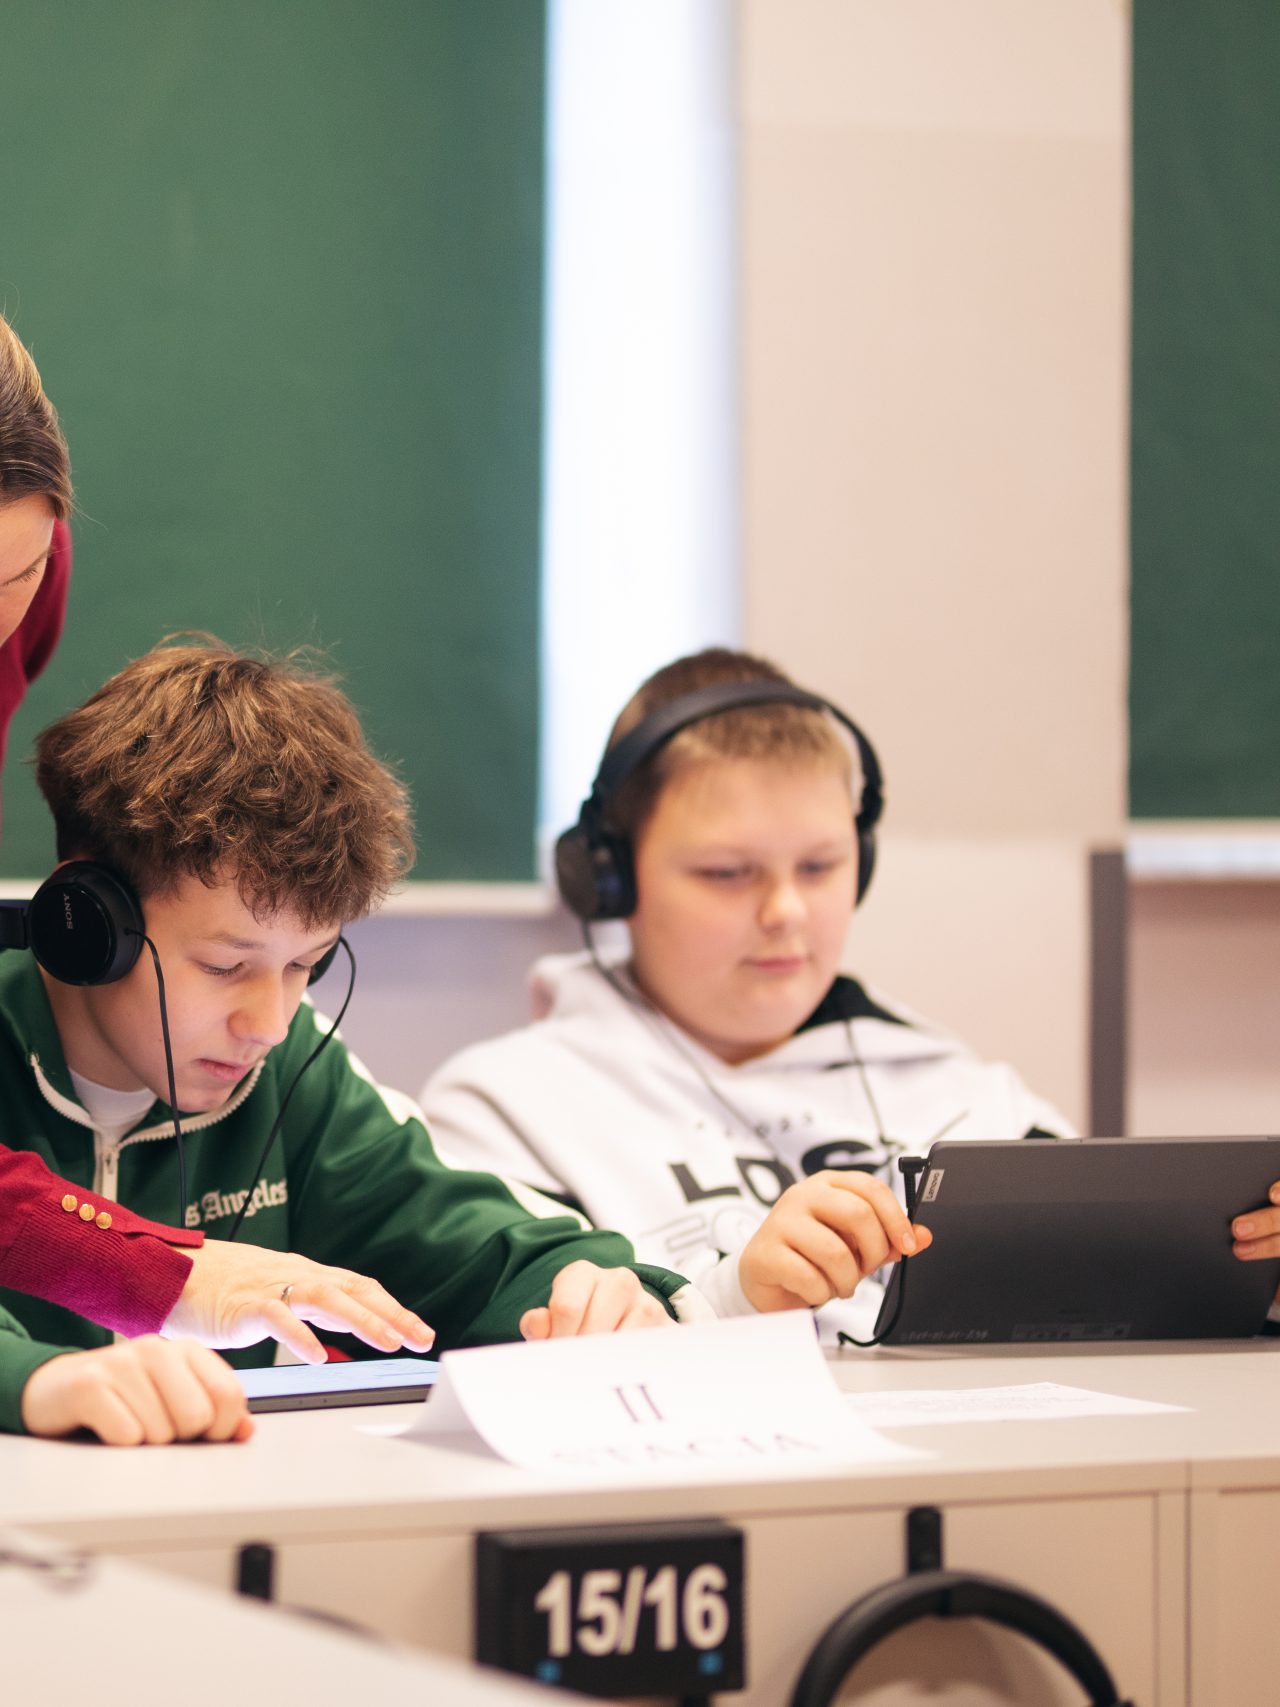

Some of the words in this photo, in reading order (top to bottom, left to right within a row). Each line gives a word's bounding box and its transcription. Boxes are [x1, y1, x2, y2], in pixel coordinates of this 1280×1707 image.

[63, 893, 73, 929] SONY
[201, 1178, 288, 1222] Angeles
[534, 1563, 730, 1657] 15/16
